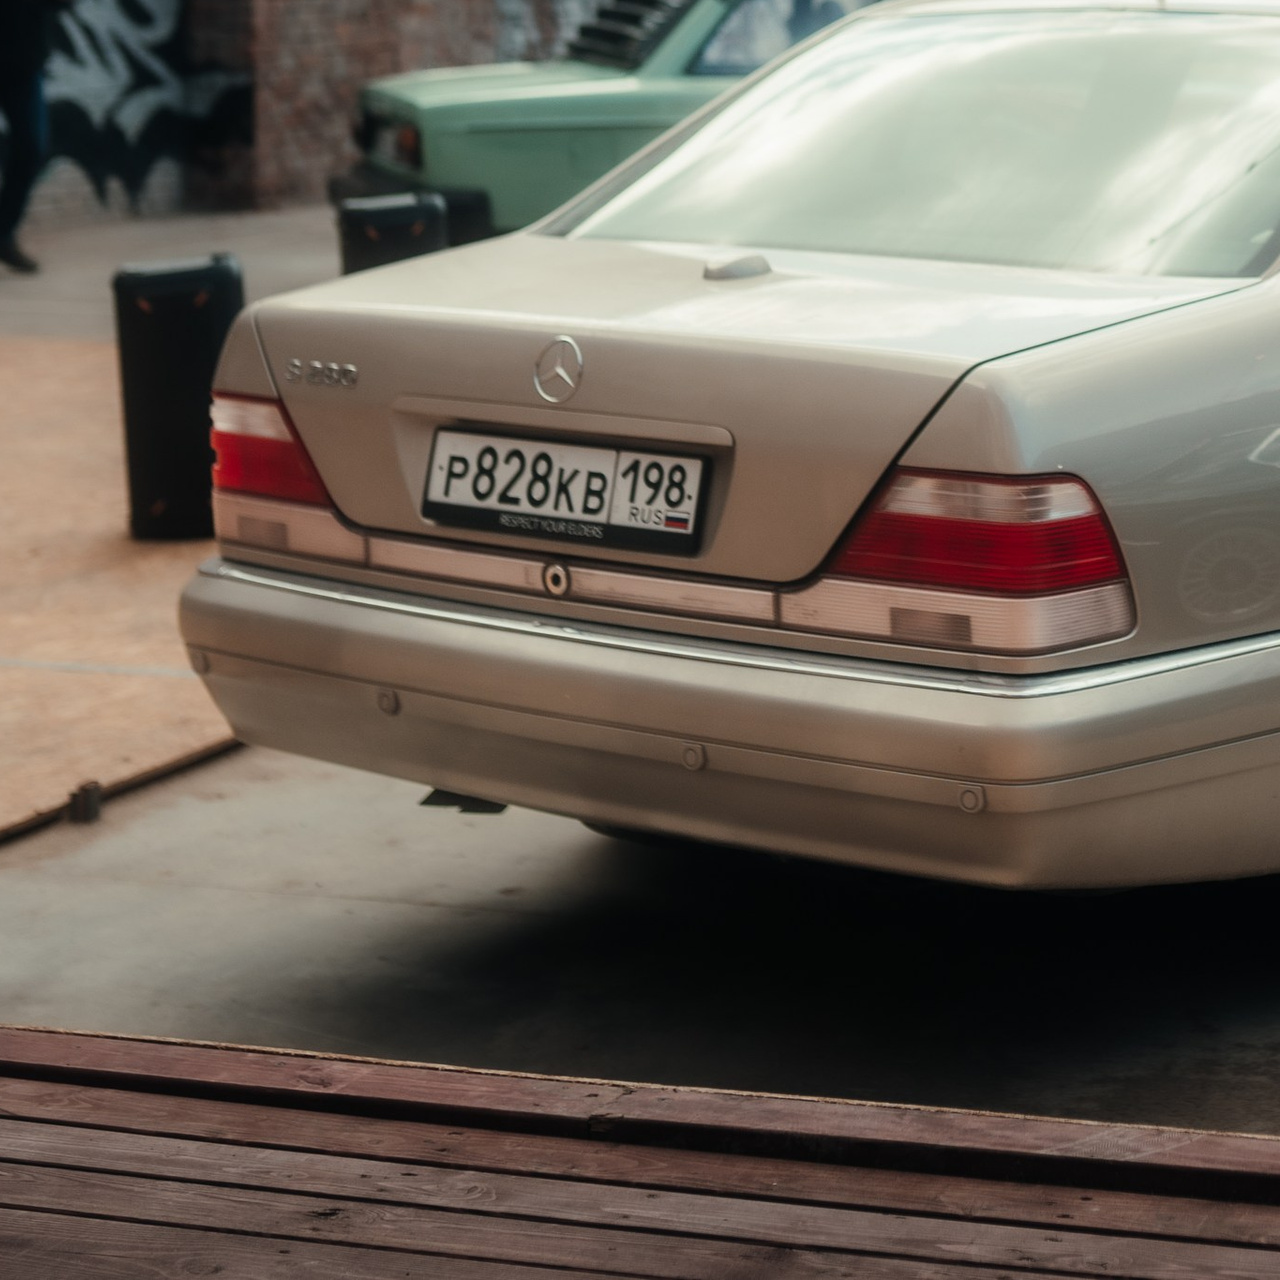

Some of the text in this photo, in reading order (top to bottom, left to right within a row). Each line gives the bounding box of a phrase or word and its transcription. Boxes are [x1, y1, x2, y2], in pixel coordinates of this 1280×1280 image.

[285, 358, 302, 383] S
[621, 459, 687, 508] 198
[628, 506, 664, 525] RUS
